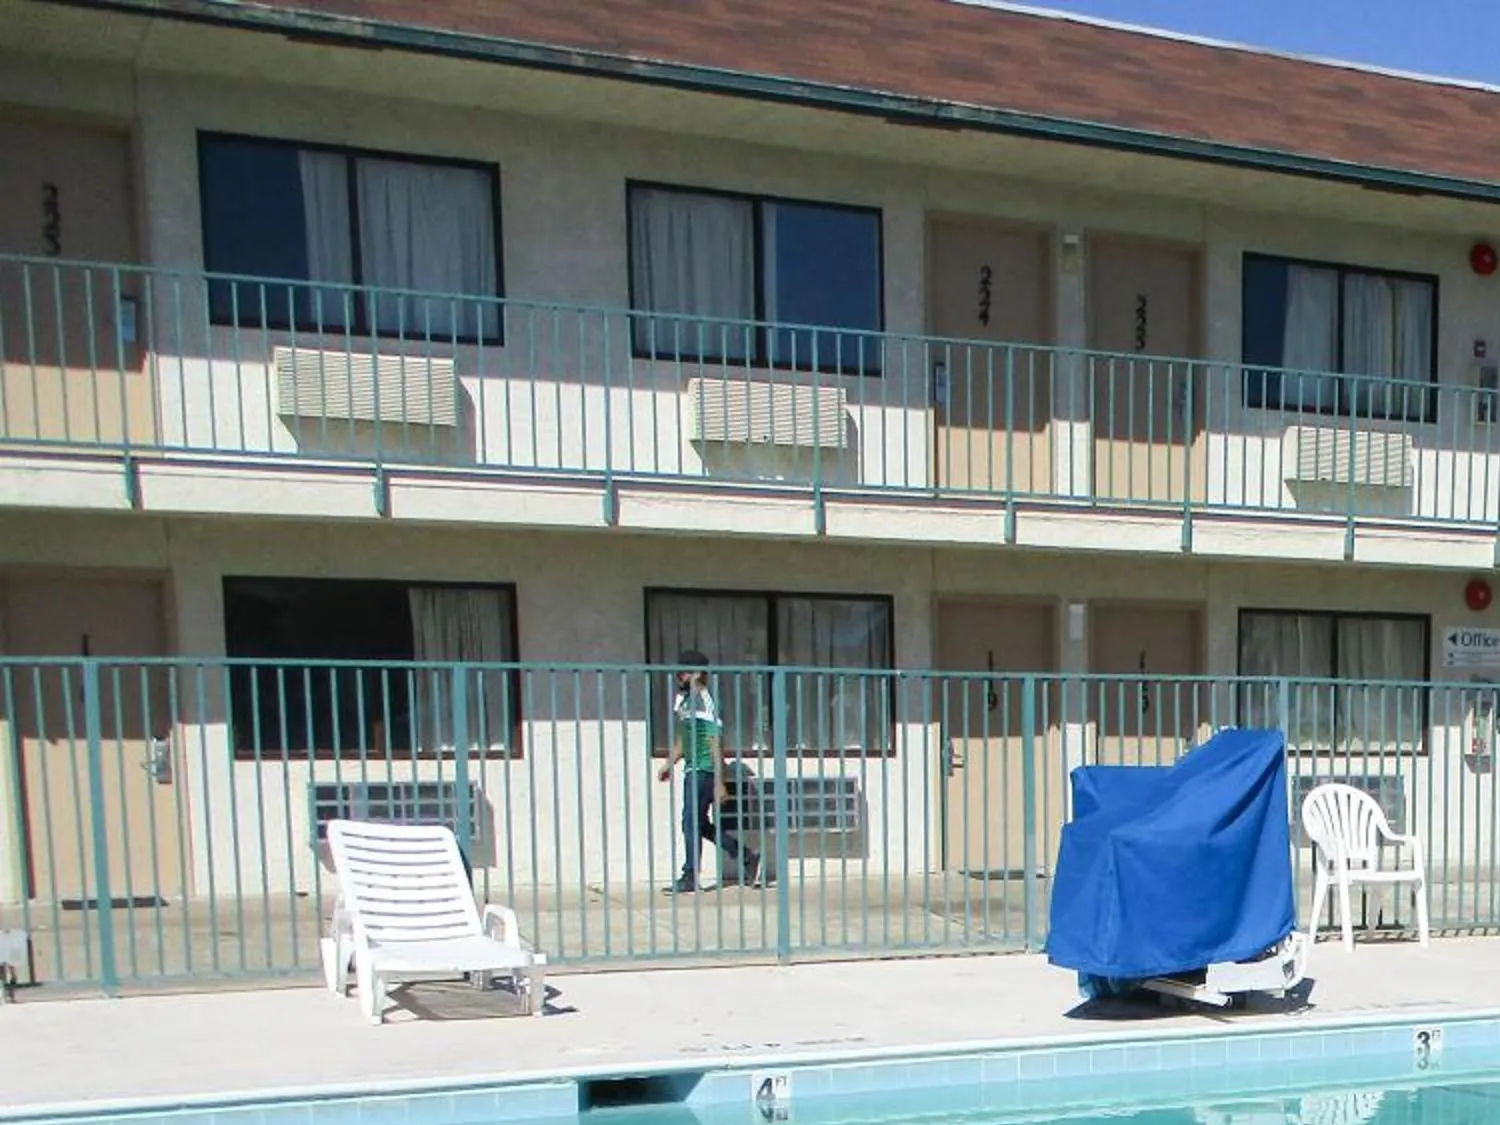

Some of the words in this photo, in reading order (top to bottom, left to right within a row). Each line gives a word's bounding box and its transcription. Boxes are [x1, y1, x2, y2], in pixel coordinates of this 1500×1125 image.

[1460, 631, 1500, 648] Office
[1417, 1031, 1431, 1055] 3
[756, 1078, 776, 1101] 4
